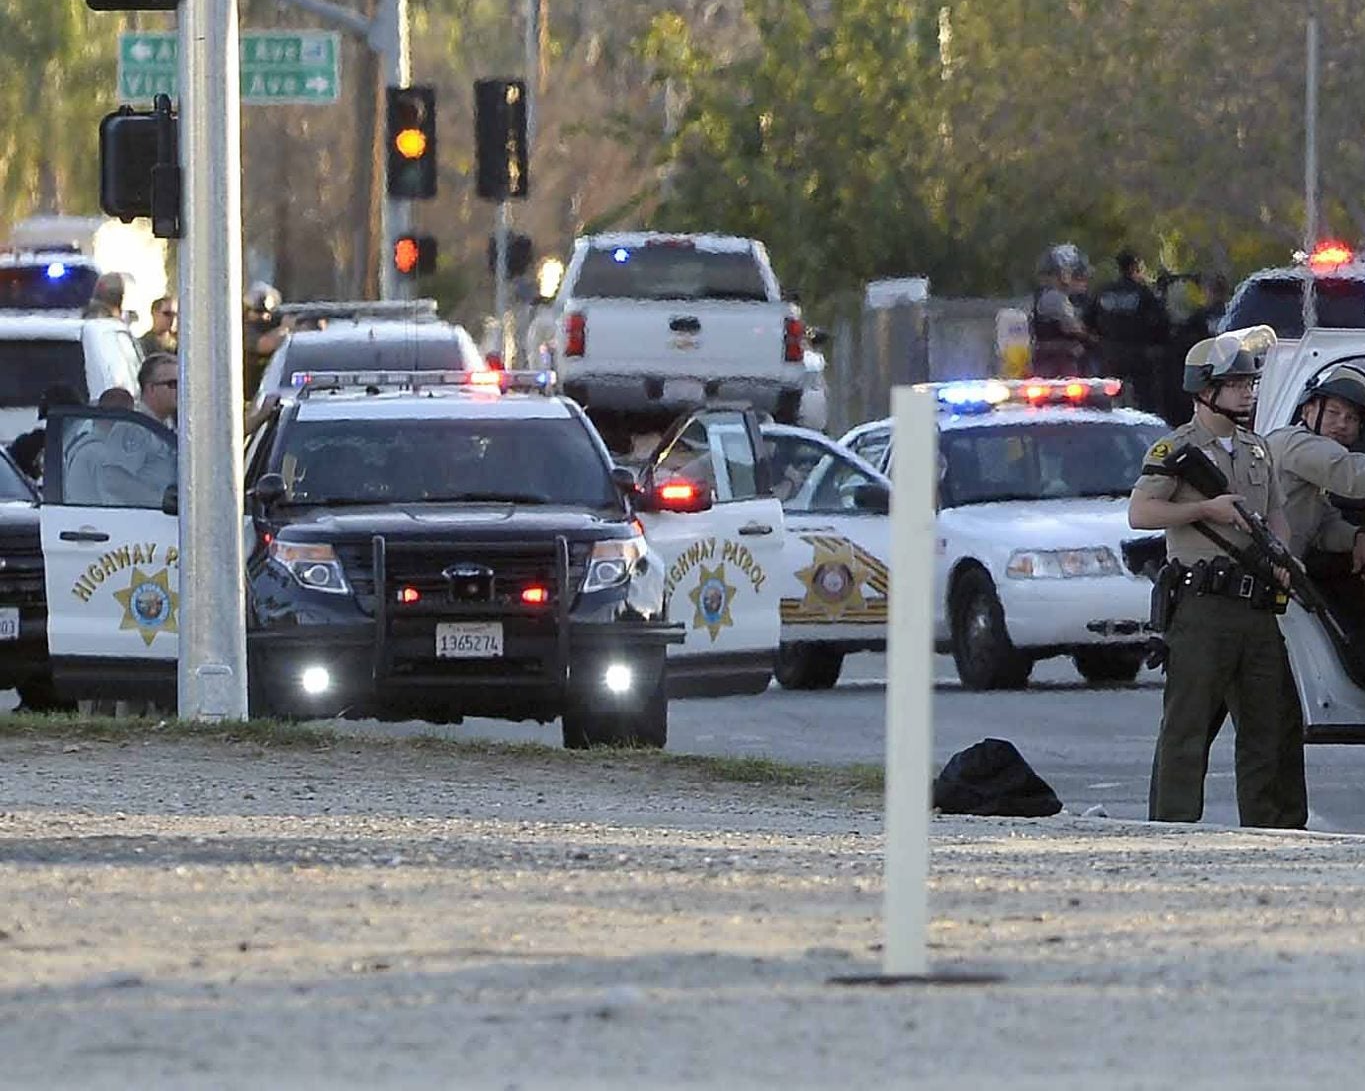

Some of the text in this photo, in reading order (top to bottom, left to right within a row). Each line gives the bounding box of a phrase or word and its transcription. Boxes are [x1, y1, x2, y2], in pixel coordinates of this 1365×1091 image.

[71, 543, 157, 602] HIGHWAY
[722, 539, 767, 594] PATROL
[440, 635, 498, 651] 1365274
